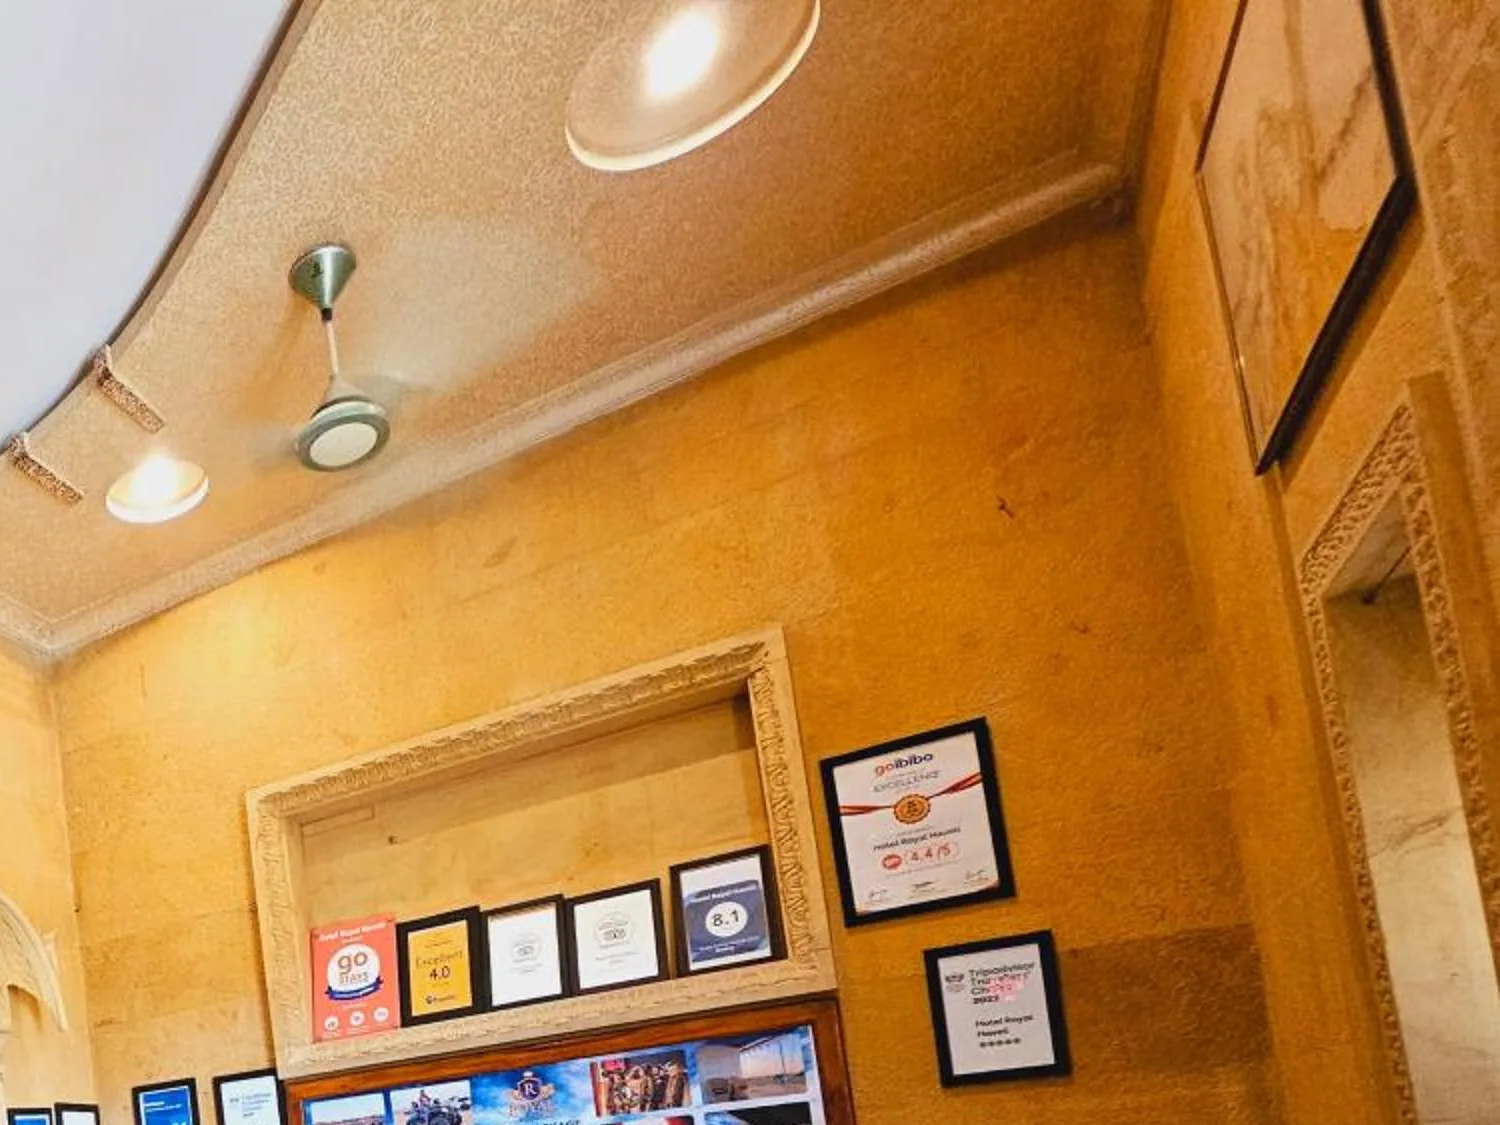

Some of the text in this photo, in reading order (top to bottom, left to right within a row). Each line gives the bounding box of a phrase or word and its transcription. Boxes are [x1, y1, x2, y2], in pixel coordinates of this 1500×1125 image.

[875, 753, 934, 777] goibibo
[712, 909, 740, 928] 8.1
[337, 951, 368, 975] go
[430, 965, 451, 980] 4.0
